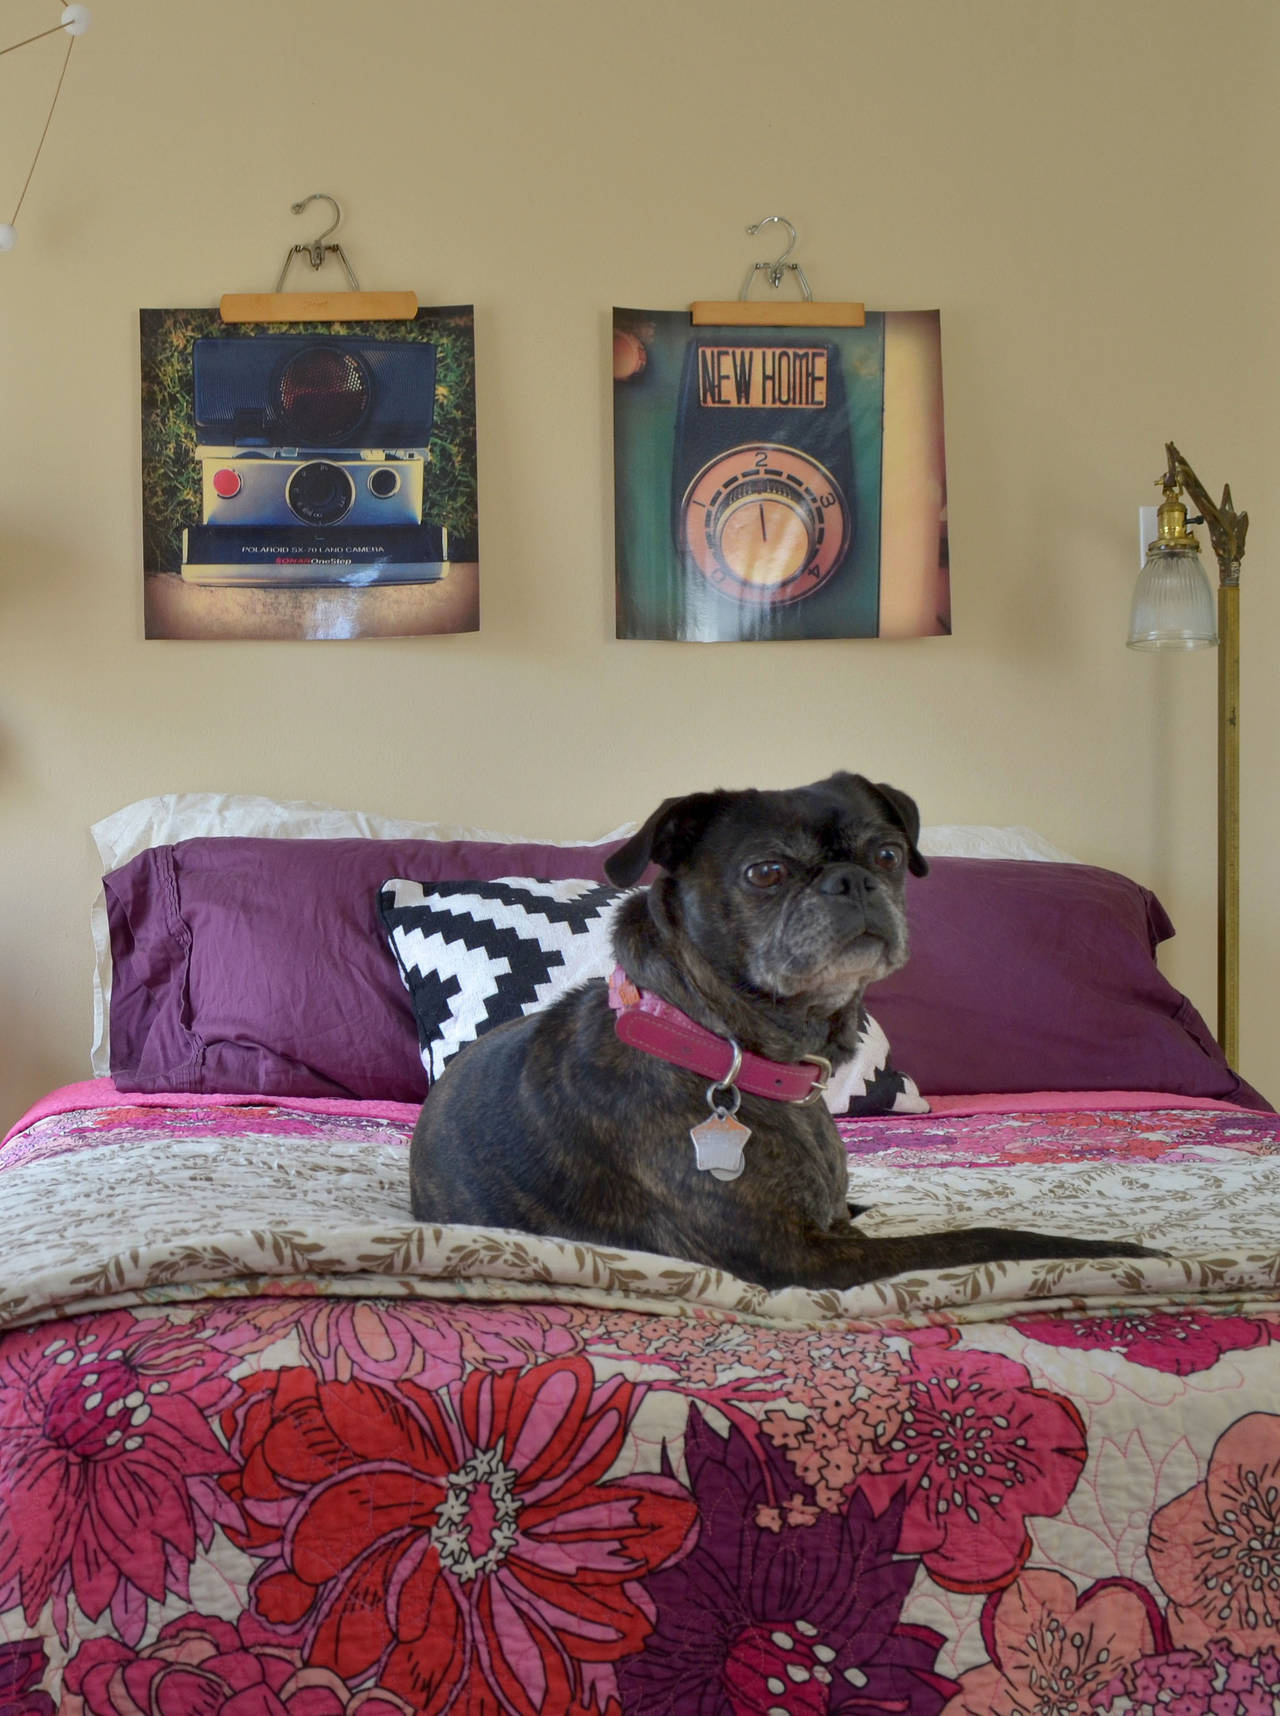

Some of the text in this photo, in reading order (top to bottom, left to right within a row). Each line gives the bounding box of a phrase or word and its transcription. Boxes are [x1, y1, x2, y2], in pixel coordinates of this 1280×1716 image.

[700, 349, 825, 406] NEW HOME
[755, 452, 768, 467] 2
[819, 492, 836, 508] 3
[808, 564, 821, 578] 4
